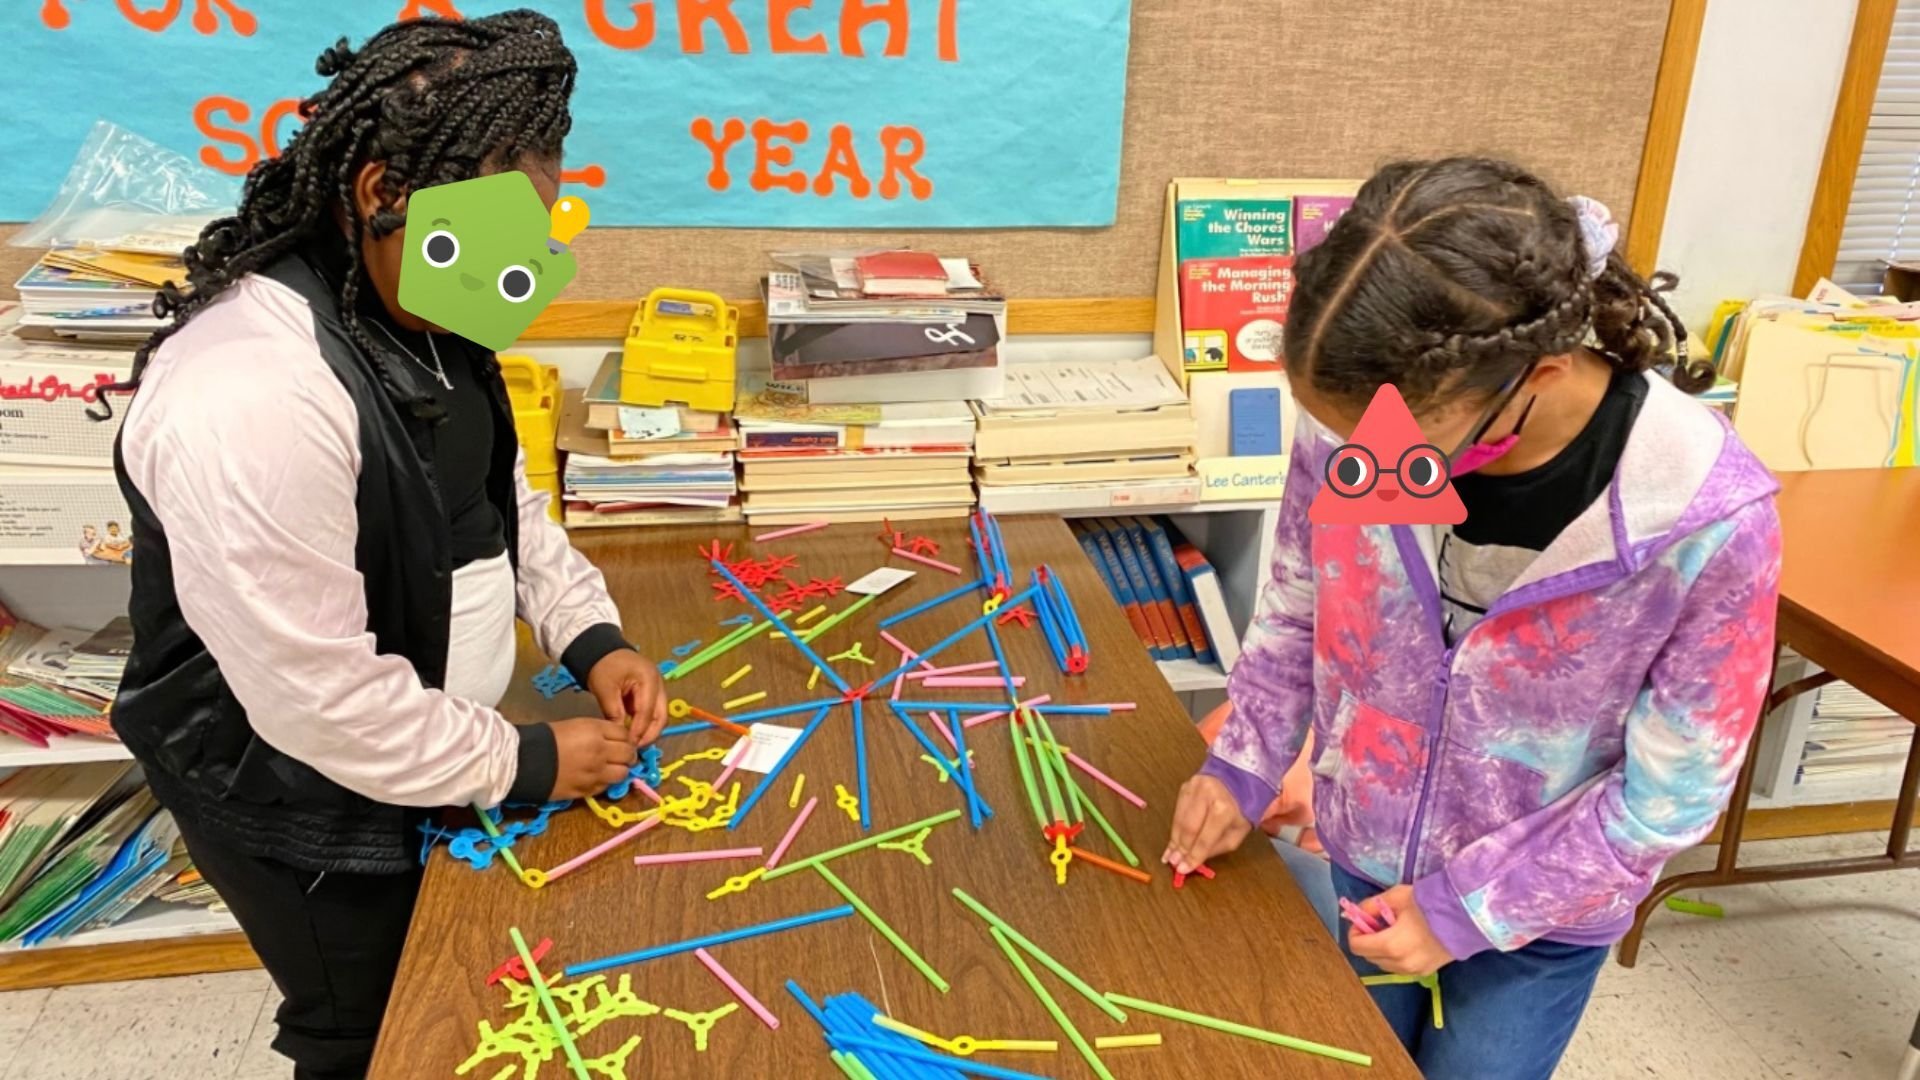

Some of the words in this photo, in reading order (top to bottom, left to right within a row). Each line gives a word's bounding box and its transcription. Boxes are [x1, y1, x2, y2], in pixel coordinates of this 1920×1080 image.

[690, 117, 933, 199] YEAR
[1223, 208, 1286, 223] Winning
[1208, 222, 1231, 233] the
[1235, 222, 1285, 233] Chores
[1247, 234, 1284, 246] Wars
[1217, 266, 1291, 281] Managing
[1202, 281, 1226, 292] the
[1230, 278, 1291, 293] Morning
[1252, 291, 1286, 303] Rush
[39, 375, 72, 402] On
[1206, 473, 1228, 488] Lee
